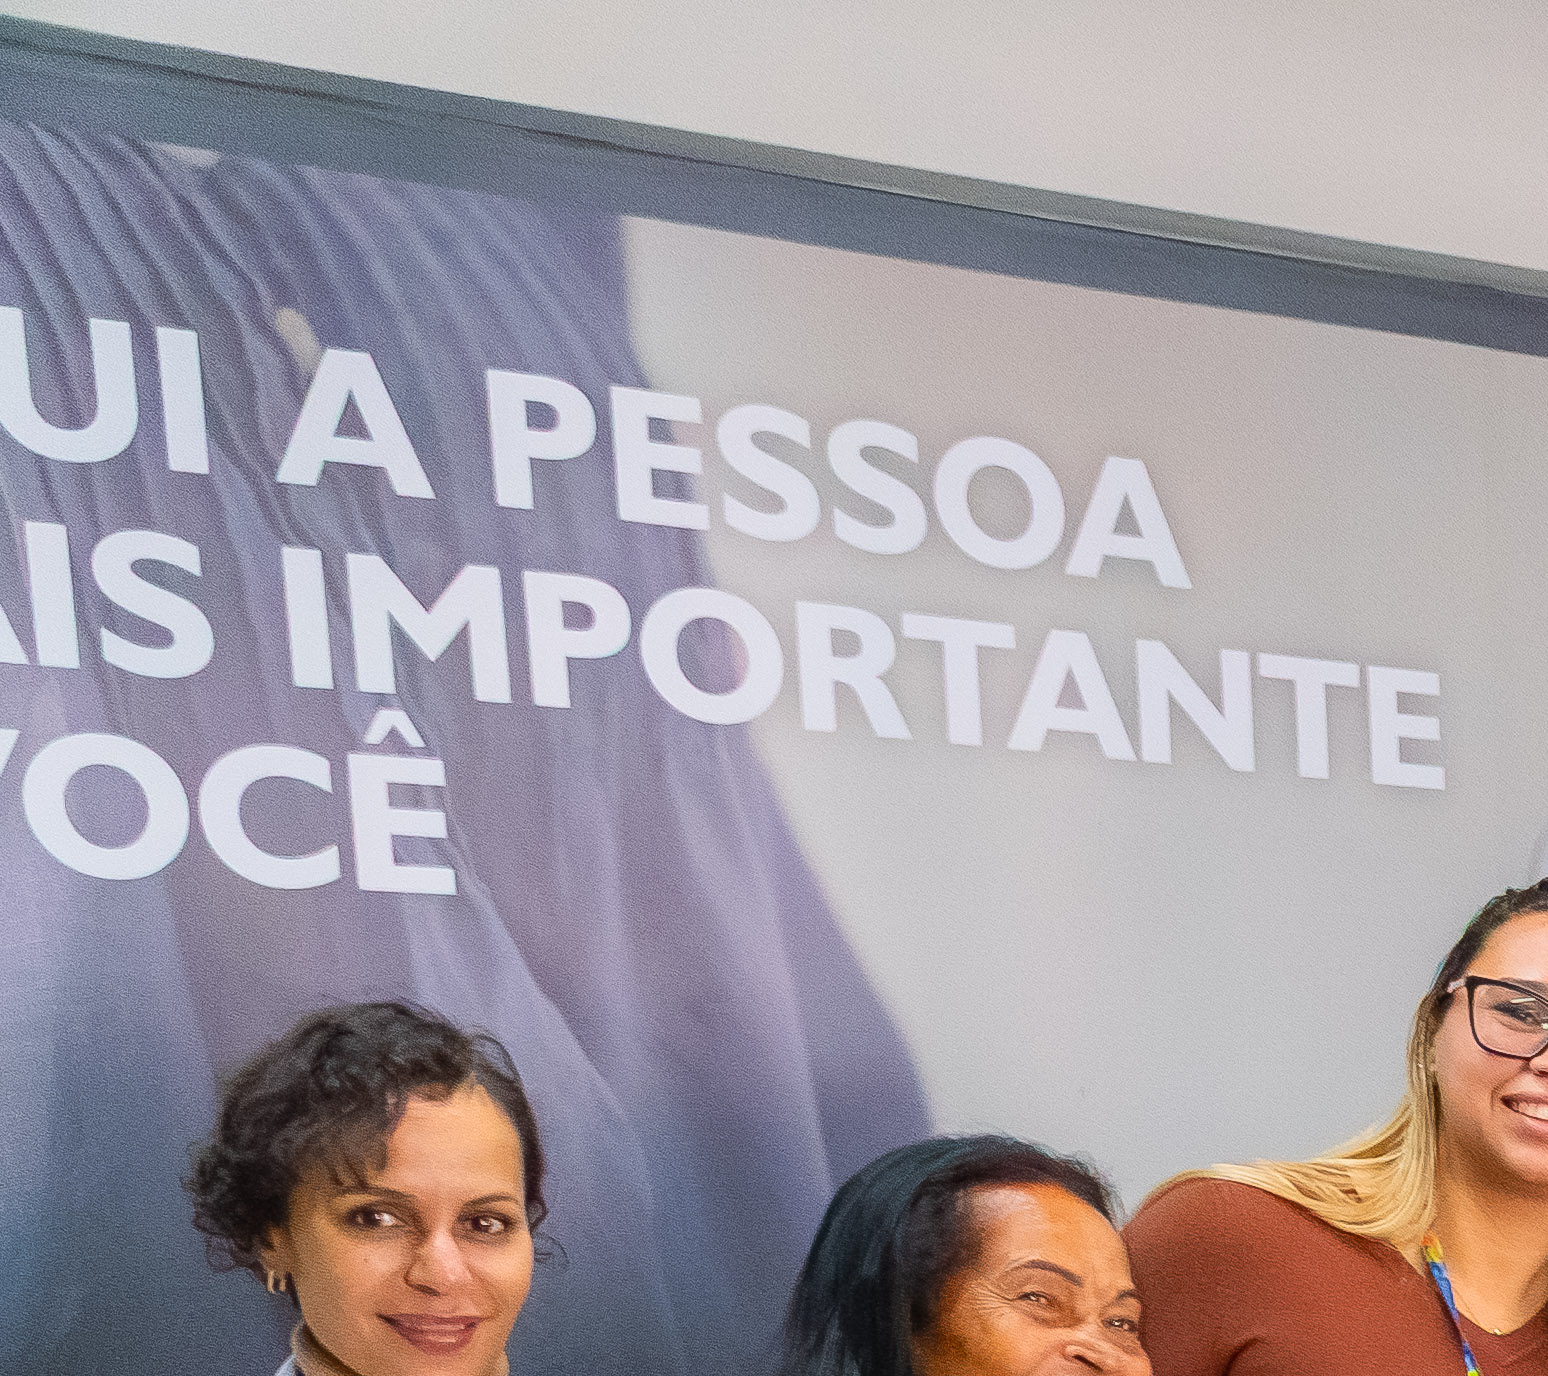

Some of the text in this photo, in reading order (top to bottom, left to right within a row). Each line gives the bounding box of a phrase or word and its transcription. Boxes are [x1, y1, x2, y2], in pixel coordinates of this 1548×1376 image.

[274, 346, 437, 500] A
[484, 366, 1192, 590] PESSOA
[0, 519, 1447, 791] IS IMPORTANTE
[0, 709, 458, 896] OCÊ
